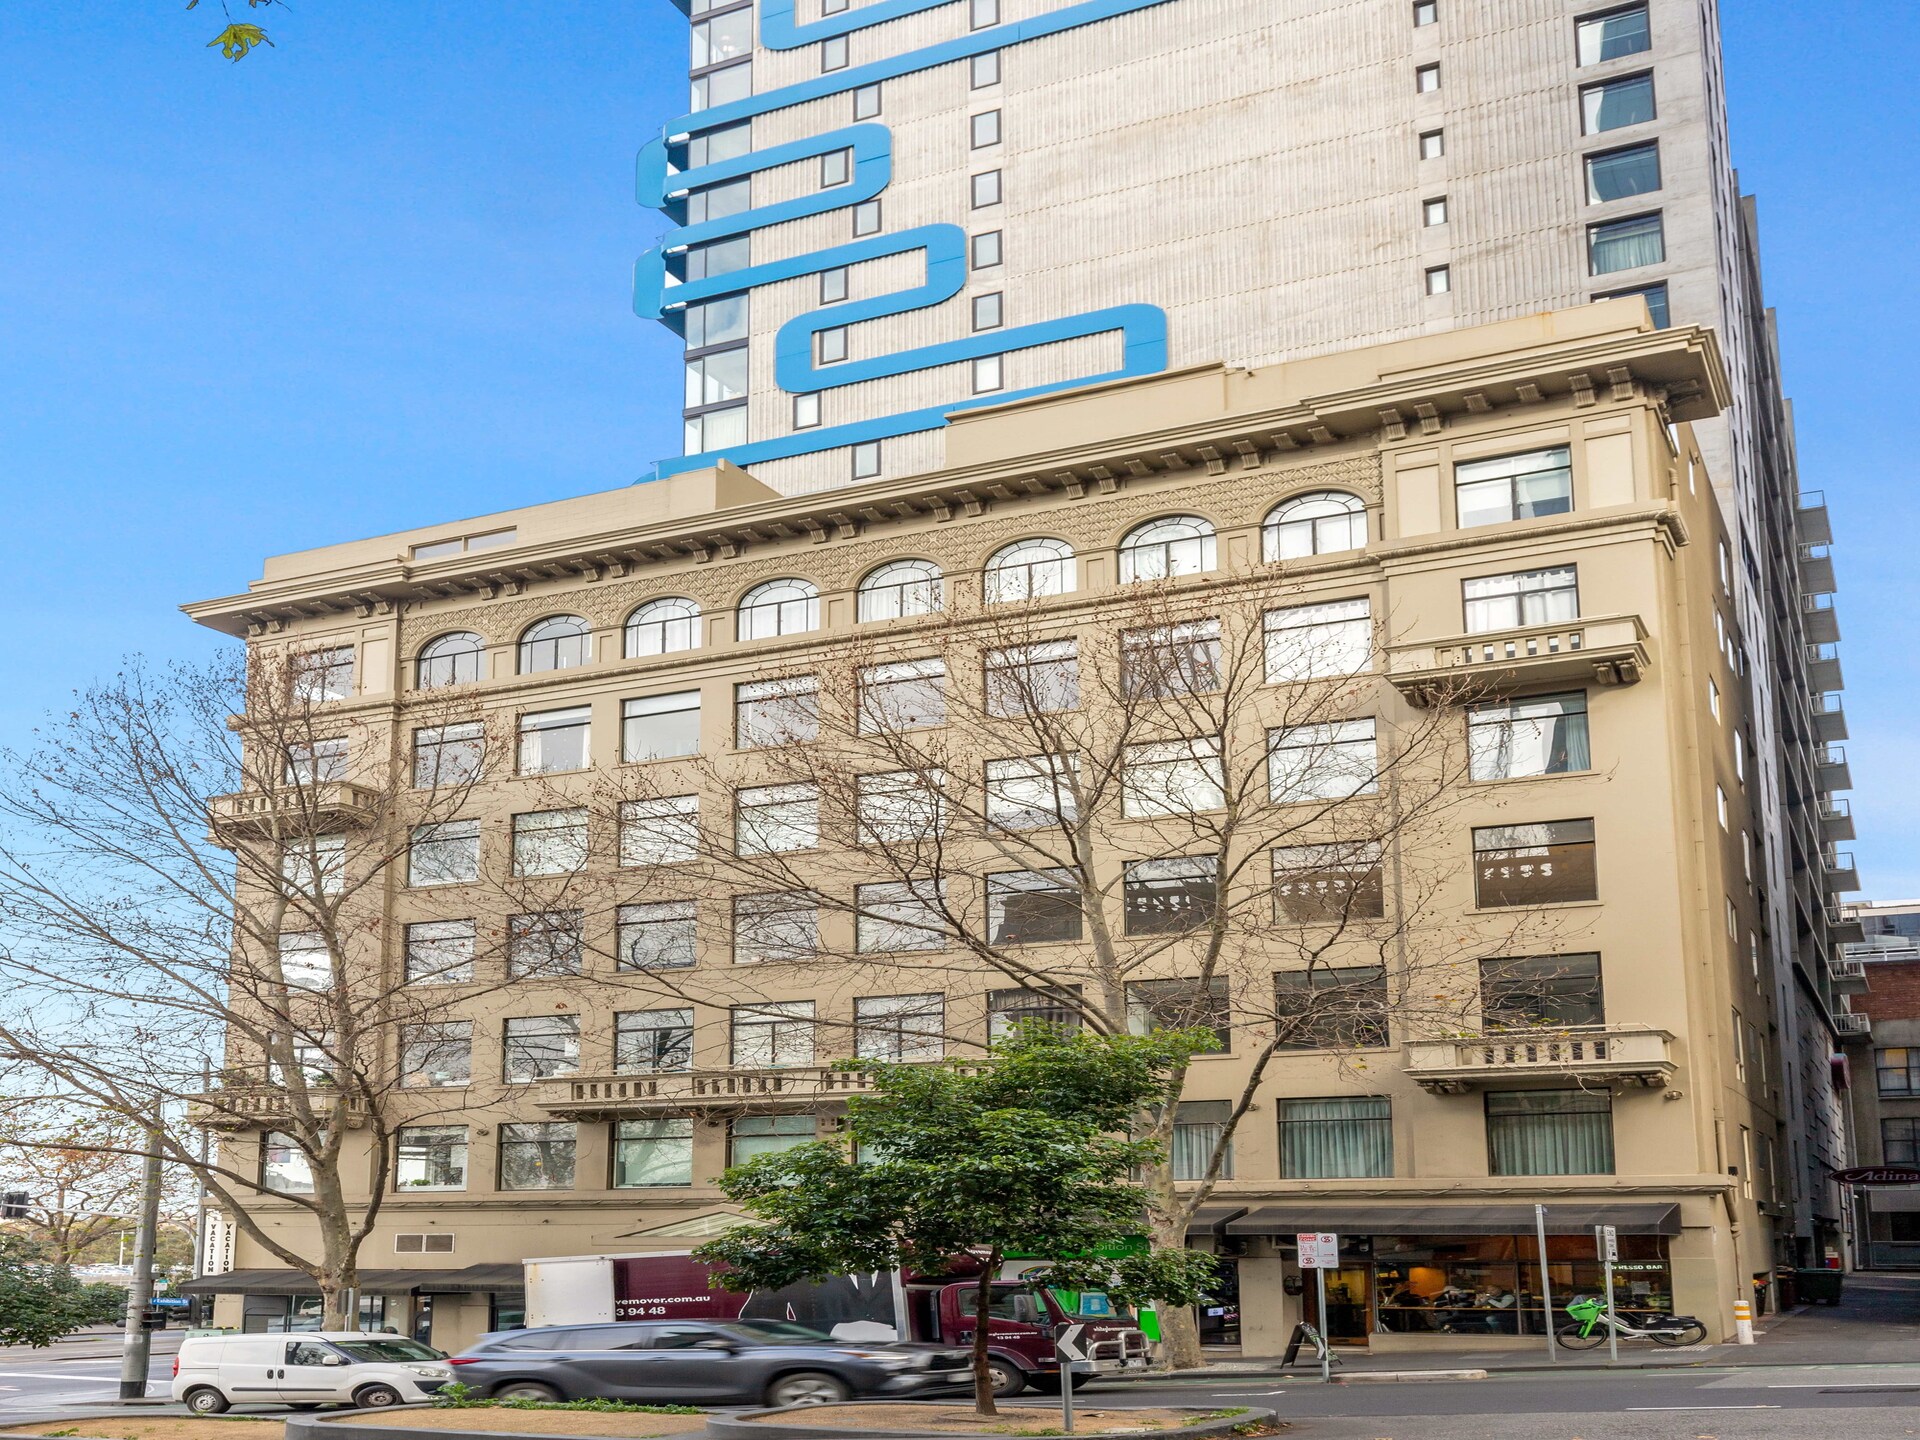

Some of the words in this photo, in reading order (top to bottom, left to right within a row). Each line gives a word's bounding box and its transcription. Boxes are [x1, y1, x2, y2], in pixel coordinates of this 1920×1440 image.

[1844, 1170, 1920, 1181] Adina
[208, 1224, 216, 1272] VACATION
[223, 1223, 232, 1272] VACATION
[627, 1307, 645, 1316] 94
[648, 1306, 666, 1315] 48
